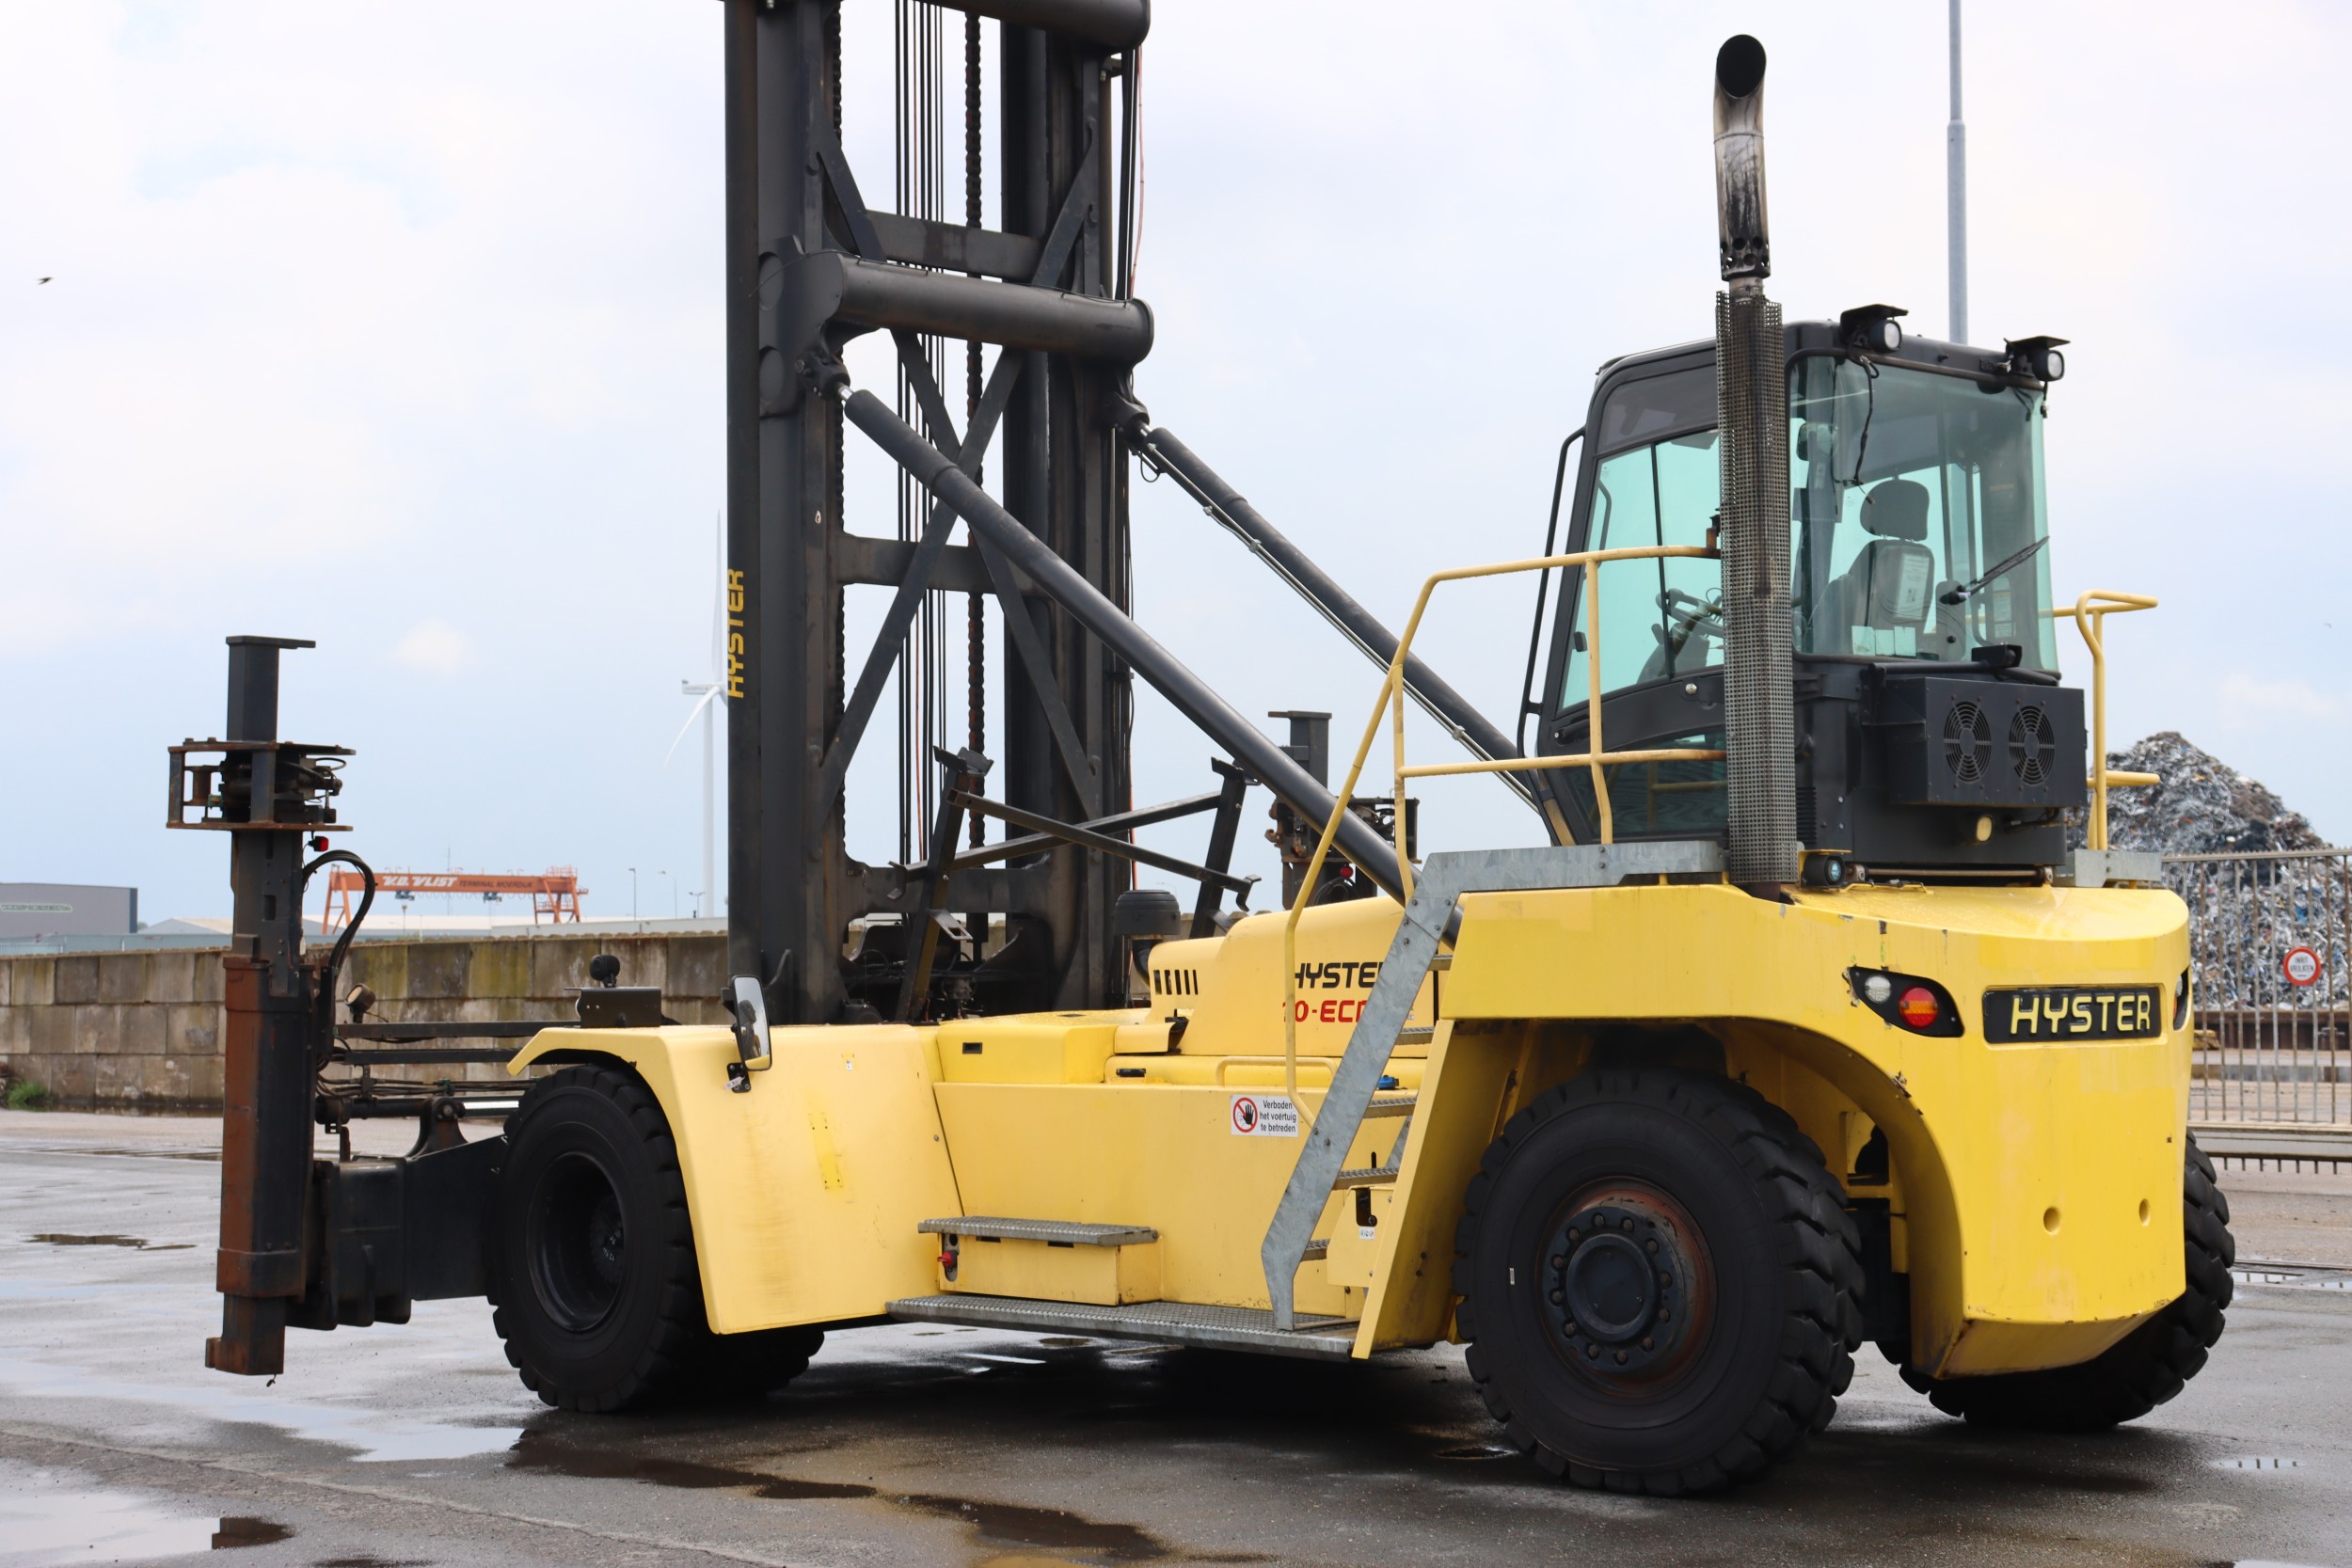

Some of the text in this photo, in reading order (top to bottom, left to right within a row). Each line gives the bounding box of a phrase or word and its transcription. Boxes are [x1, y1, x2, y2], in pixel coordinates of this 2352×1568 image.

[727, 568, 744, 699] HYSTER
[412, 876, 458, 887] VLIST
[1295, 962, 1384, 989] HYSTE
[2010, 994, 2151, 1035] HYSTER
[1263, 1101, 1293, 1110] Verboden
[1260, 1112, 1296, 1123] het voertuig
[1268, 1124, 1296, 1132] betreden
